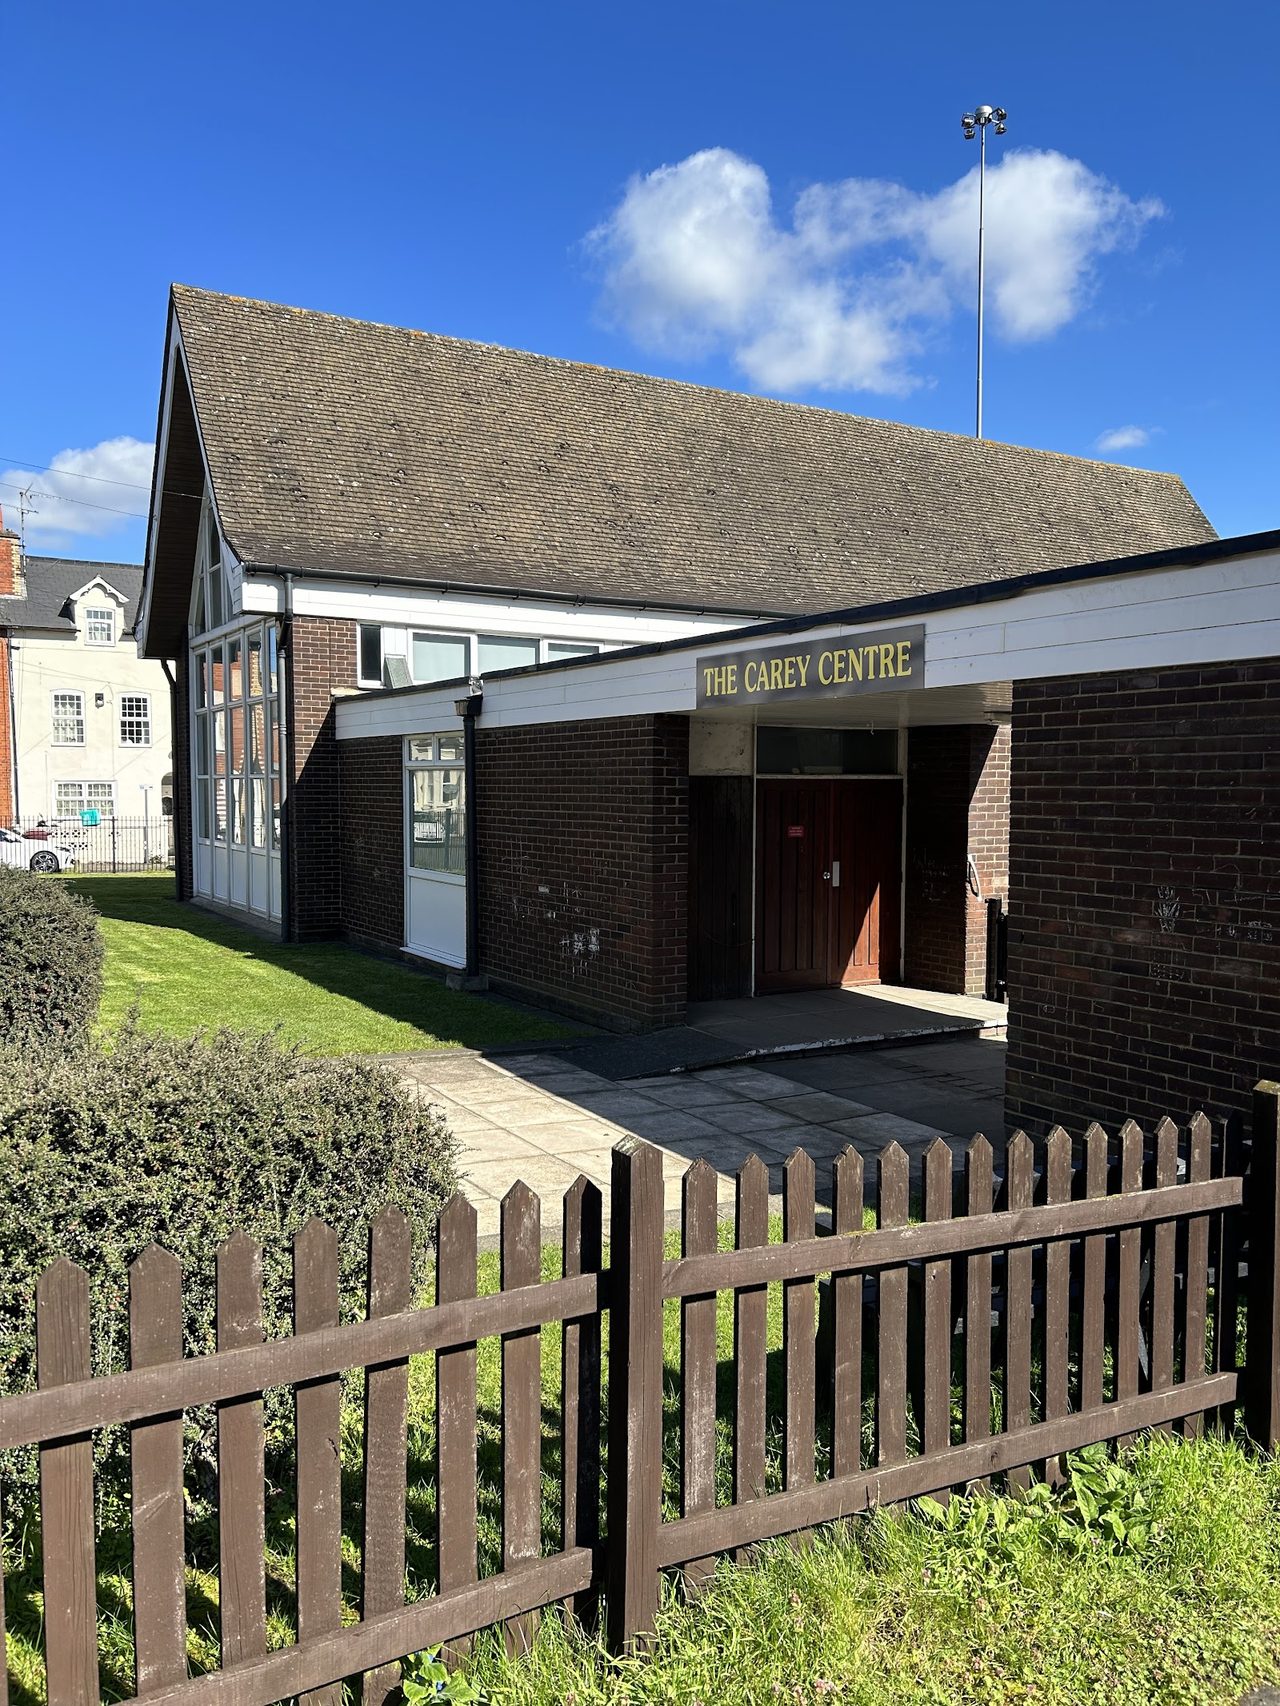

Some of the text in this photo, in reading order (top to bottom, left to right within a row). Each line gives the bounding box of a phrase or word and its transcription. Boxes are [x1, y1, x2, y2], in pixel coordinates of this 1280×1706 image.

[703, 641, 912, 696] THE CAREY CENTRE
